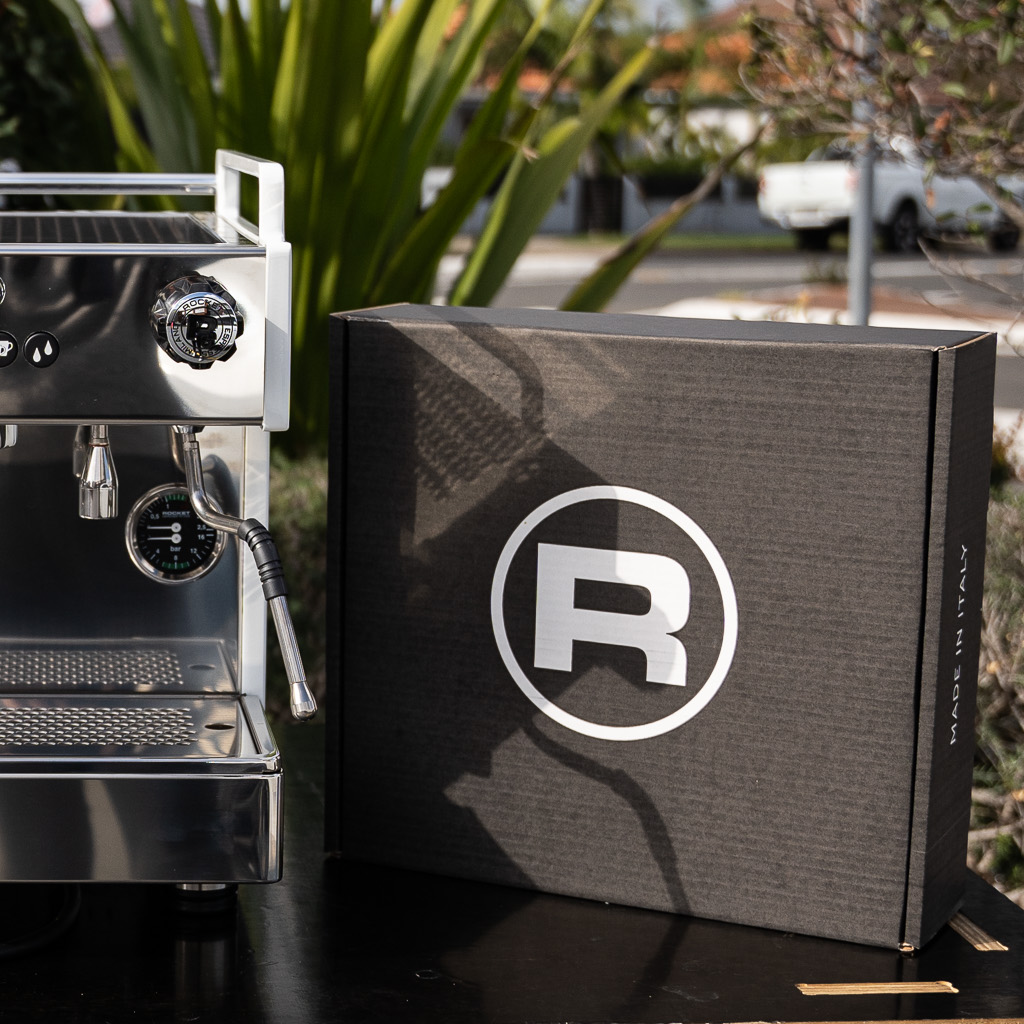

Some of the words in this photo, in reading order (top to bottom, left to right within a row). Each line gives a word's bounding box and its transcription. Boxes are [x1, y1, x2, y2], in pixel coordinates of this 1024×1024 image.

[182, 298, 226, 314] ROCKET
[534, 542, 691, 687] R
[957, 544, 968, 618] ITALY
[955, 628, 963, 656] IN
[950, 663, 961, 745] MADE
